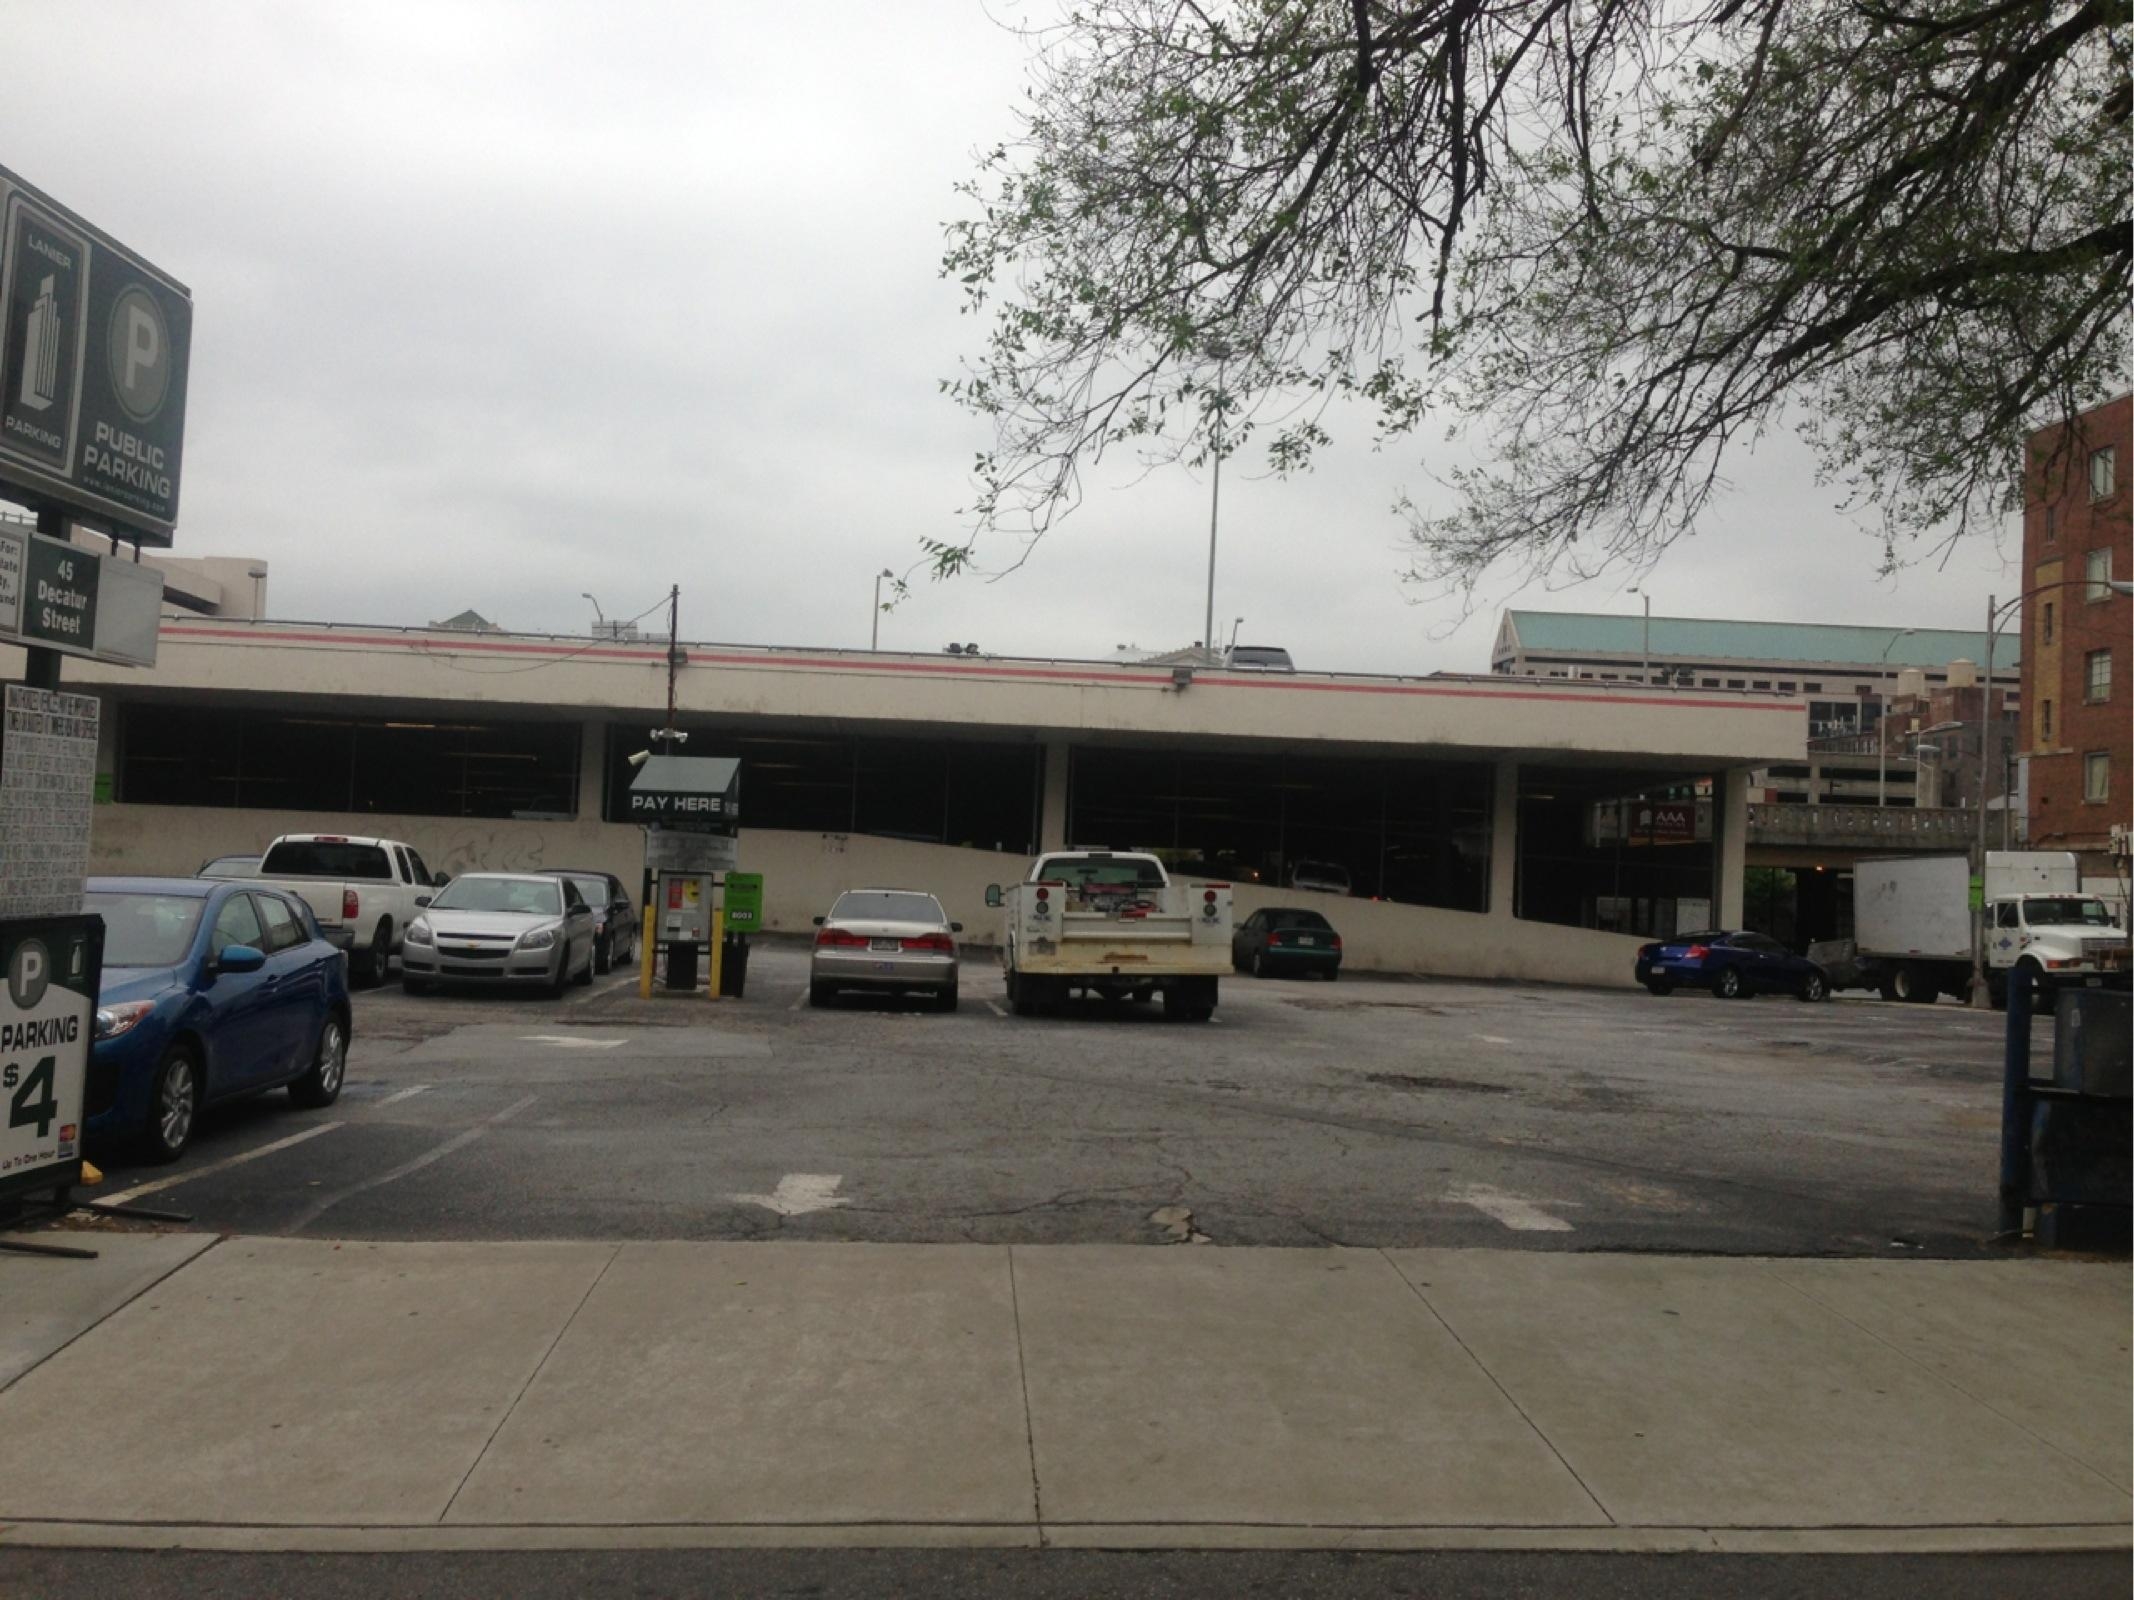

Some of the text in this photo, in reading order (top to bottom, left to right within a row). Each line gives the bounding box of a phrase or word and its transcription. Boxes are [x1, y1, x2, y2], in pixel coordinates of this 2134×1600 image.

[28, 234, 71, 270] LANIER
[6, 415, 62, 449] PARKING
[96, 421, 165, 470] PUBLIC
[83, 444, 171, 499] PARKING
[57, 560, 74, 581] 45
[37, 580, 88, 610] Decatur
[42, 607, 81, 634] Street
[632, 796, 668, 810] PAY
[674, 797, 721, 812] HERE
[1, 1015, 79, 1050] PARKING
